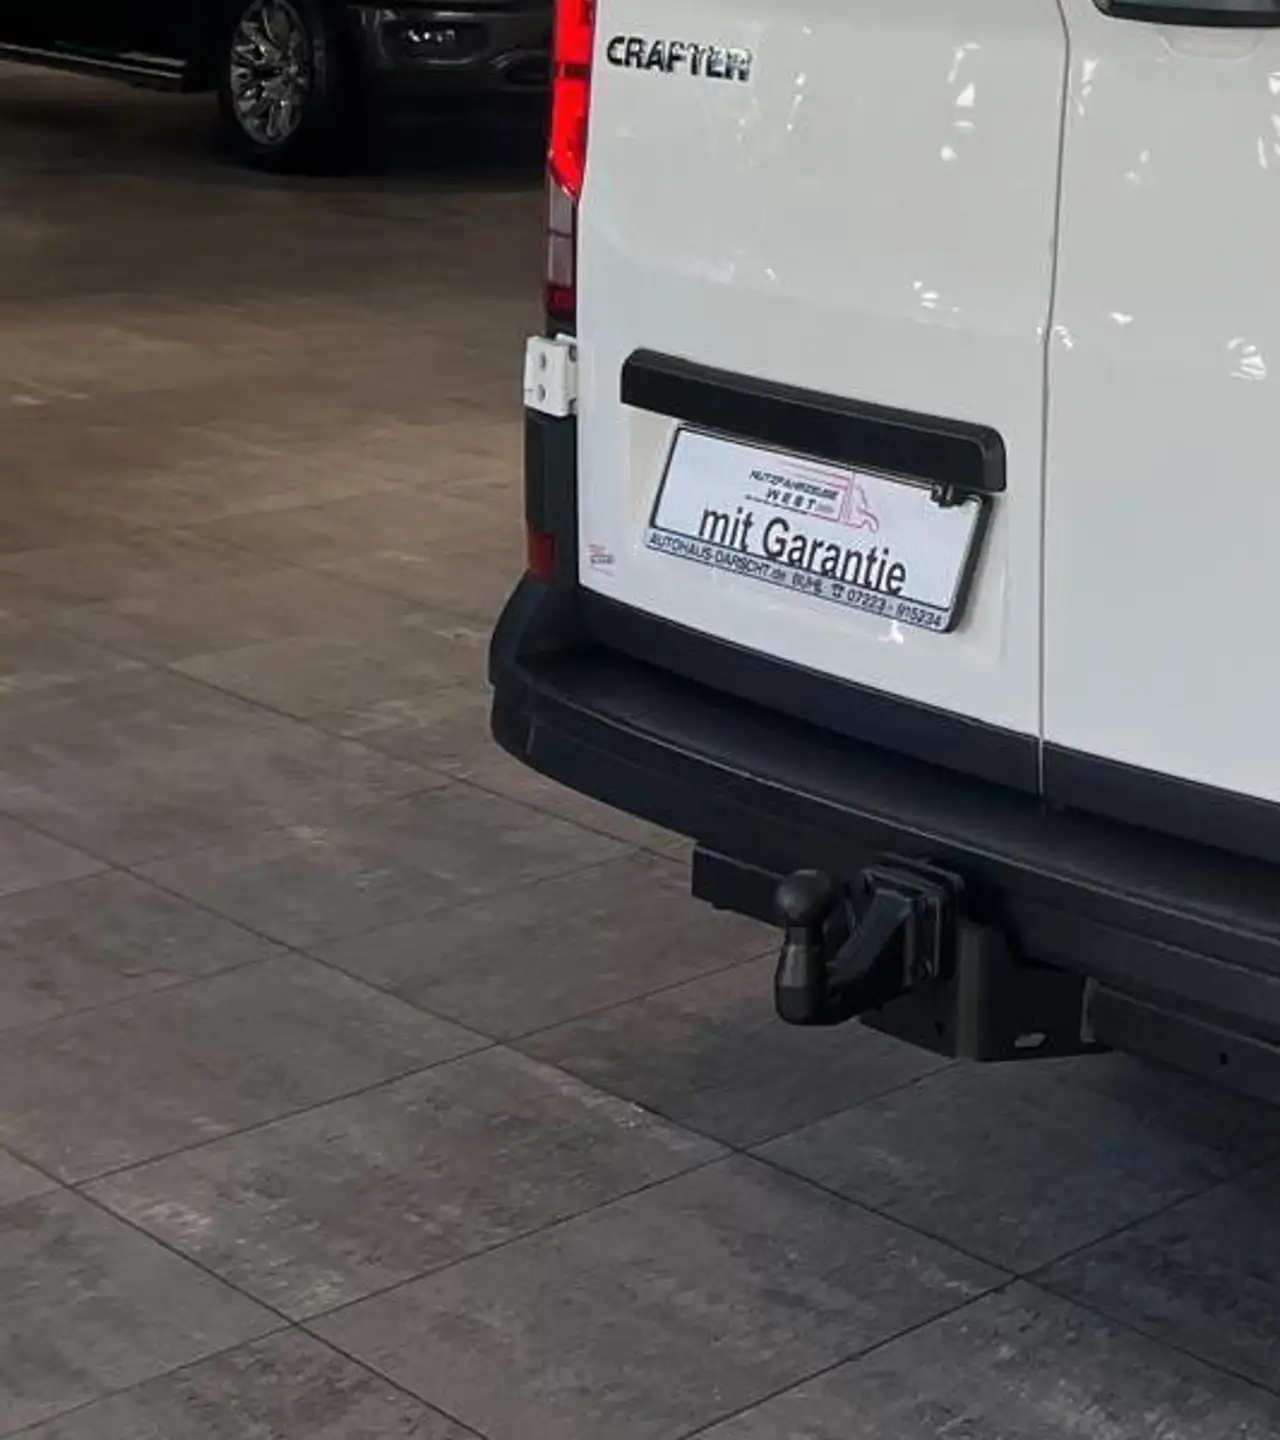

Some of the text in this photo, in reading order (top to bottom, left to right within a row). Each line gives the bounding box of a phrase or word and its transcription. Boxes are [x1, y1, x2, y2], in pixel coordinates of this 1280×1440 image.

[606, 35, 754, 82] CRAFTER
[699, 506, 907, 595] mit Garantie
